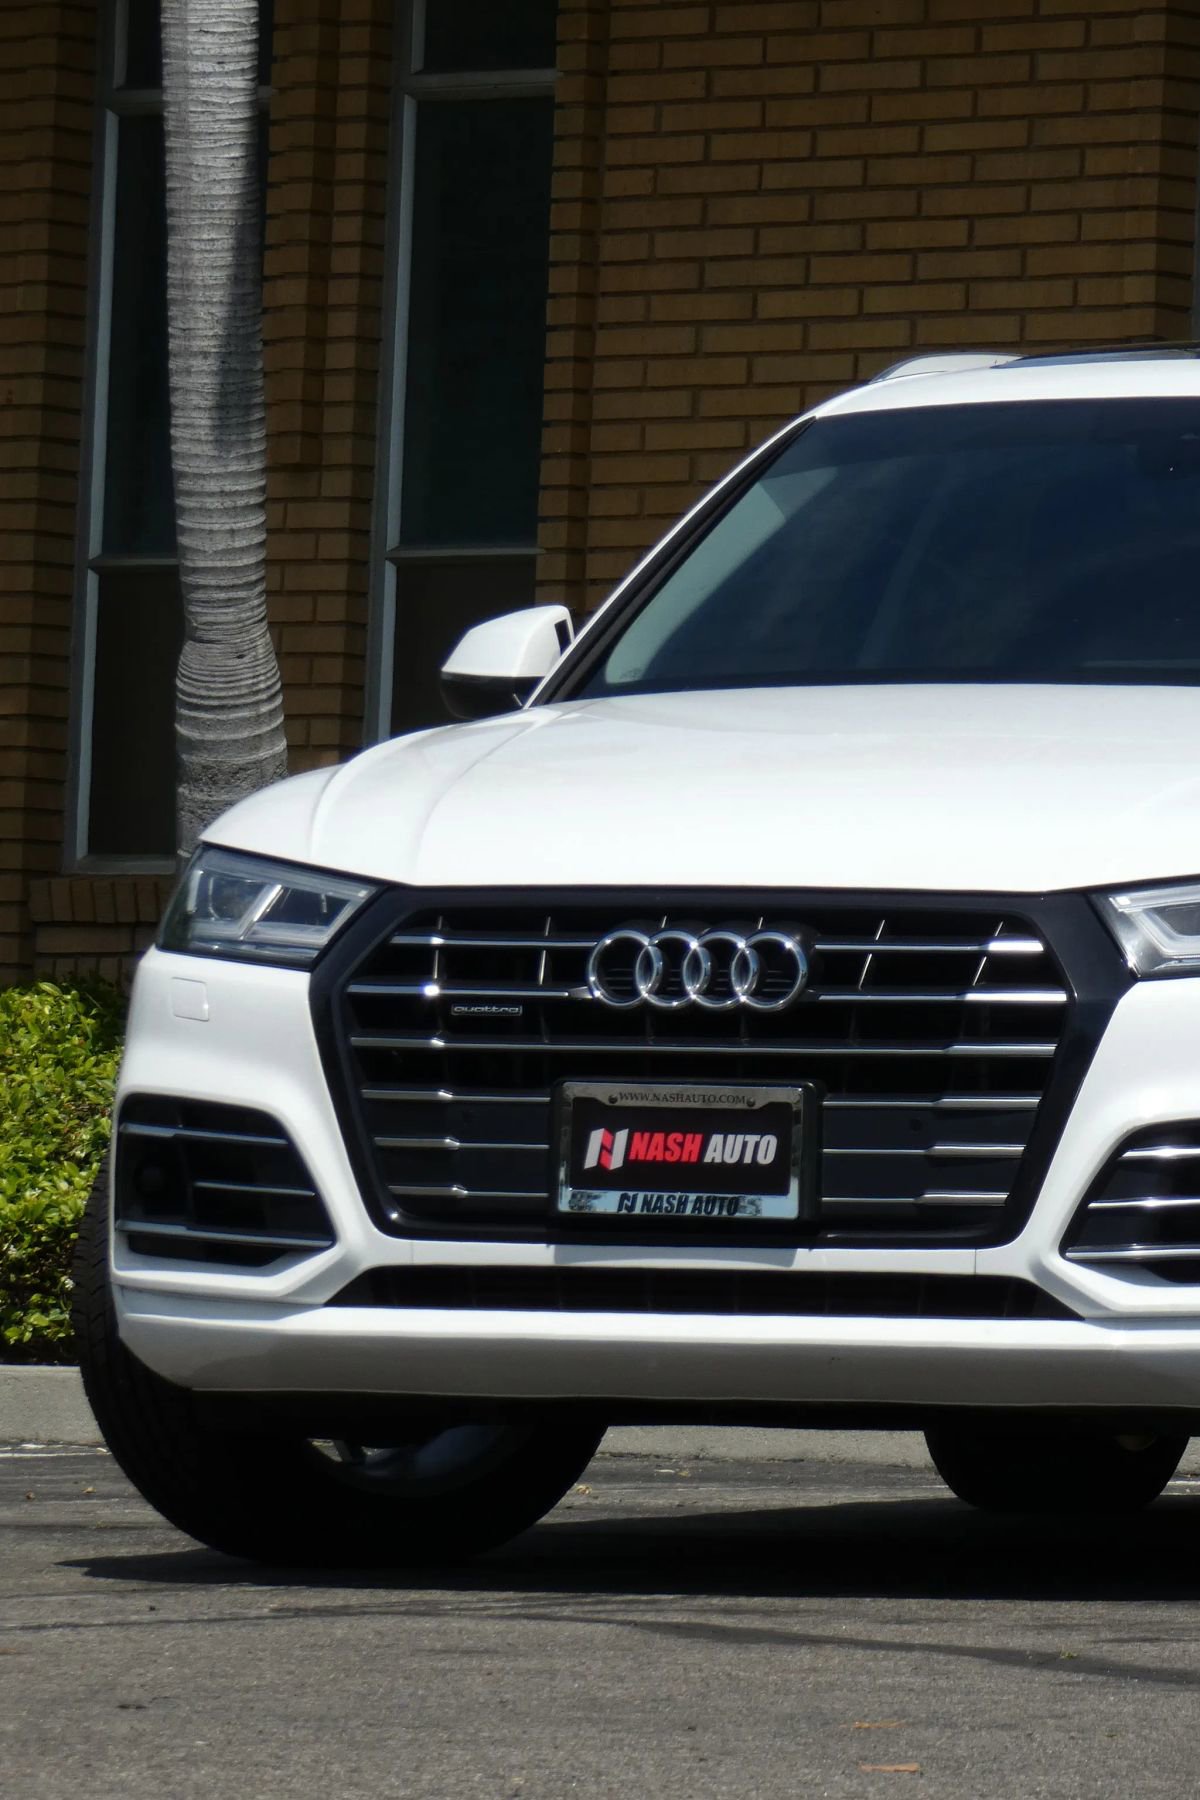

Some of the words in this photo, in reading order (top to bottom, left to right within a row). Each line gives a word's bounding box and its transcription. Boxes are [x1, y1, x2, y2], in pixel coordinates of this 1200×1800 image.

[619, 1091, 747, 1105] WWW.NASHAUTO.COM
[628, 1131, 703, 1162] NASH
[703, 1133, 778, 1165] AUTO
[640, 1193, 688, 1215] NASH
[690, 1195, 740, 1216] AUTO
